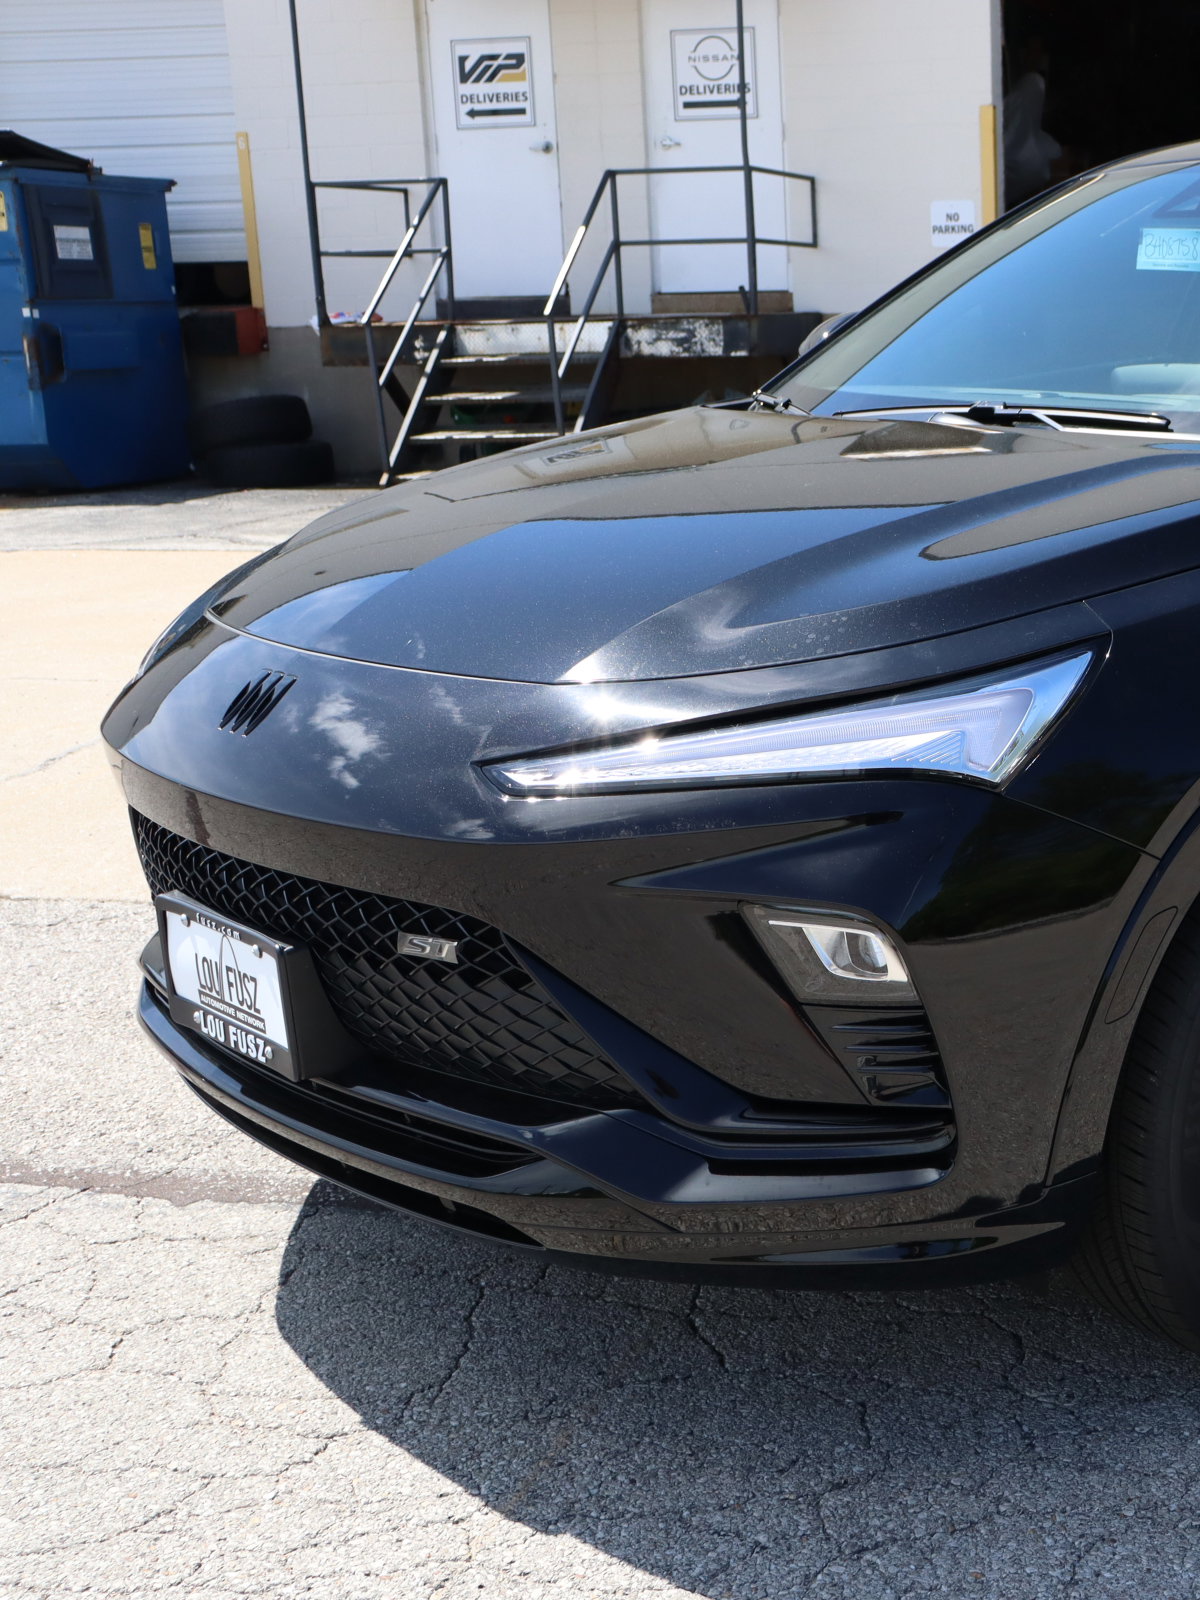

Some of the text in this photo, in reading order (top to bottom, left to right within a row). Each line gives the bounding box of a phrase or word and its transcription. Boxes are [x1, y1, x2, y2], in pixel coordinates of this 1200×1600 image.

[458, 52, 527, 84] VIP
[688, 52, 740, 64] NISSAN
[460, 91, 528, 105] DELIVERIES
[945, 212, 960, 222] NO
[932, 224, 974, 235] PARKING
[406, 937, 458, 959] ST
[195, 952, 261, 1014] LOU FUSZ
[201, 994, 265, 1030] AUTOMOTIVE NETWORK
[199, 1010, 267, 1063] LOU FUSZ
